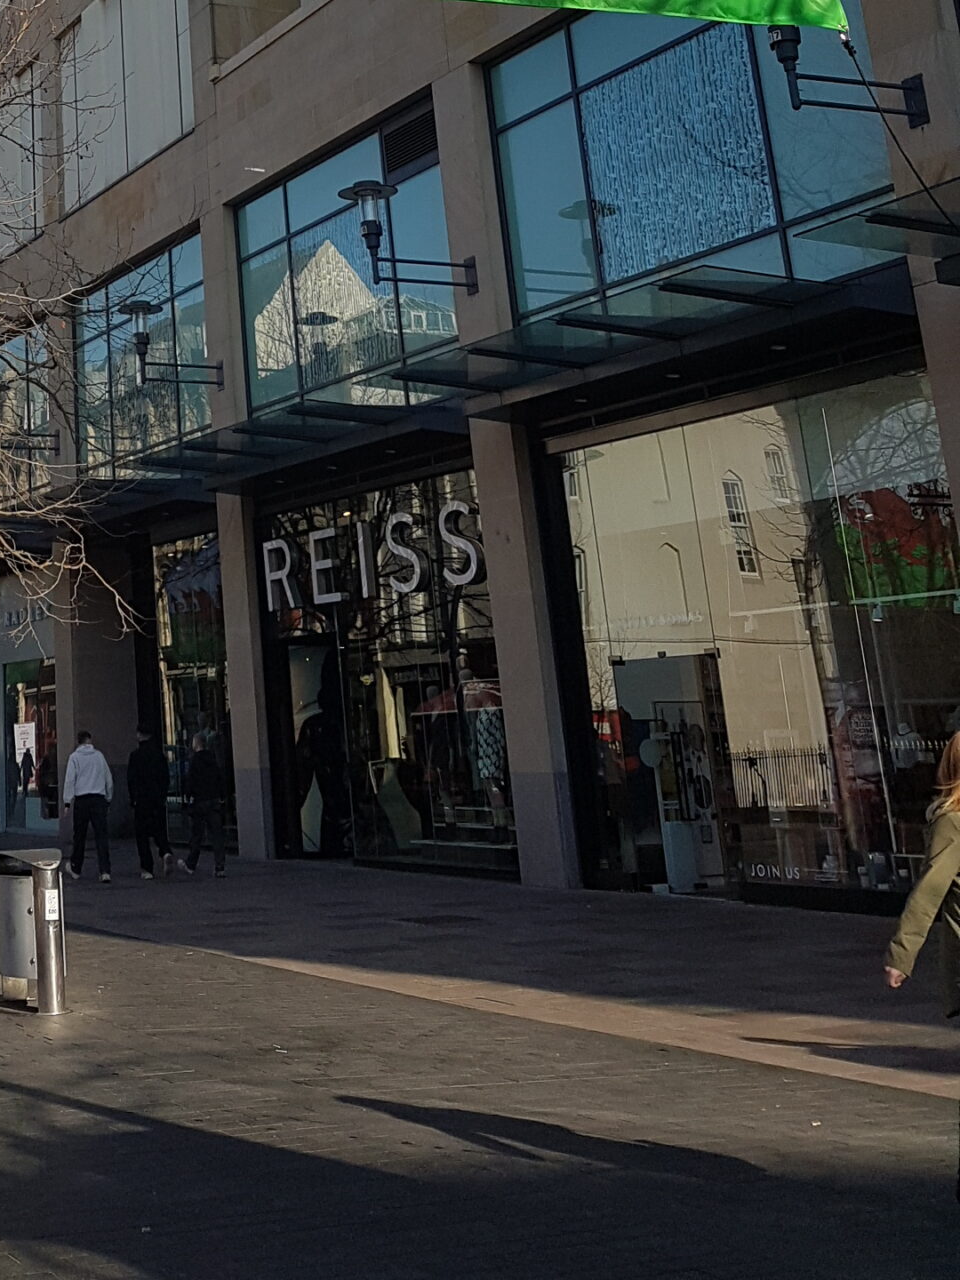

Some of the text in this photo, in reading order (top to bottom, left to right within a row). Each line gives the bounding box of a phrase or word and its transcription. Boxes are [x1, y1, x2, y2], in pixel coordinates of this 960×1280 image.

[262, 500, 481, 612] REISS
[751, 863, 781, 879] JOIN
[784, 866, 801, 880] US
